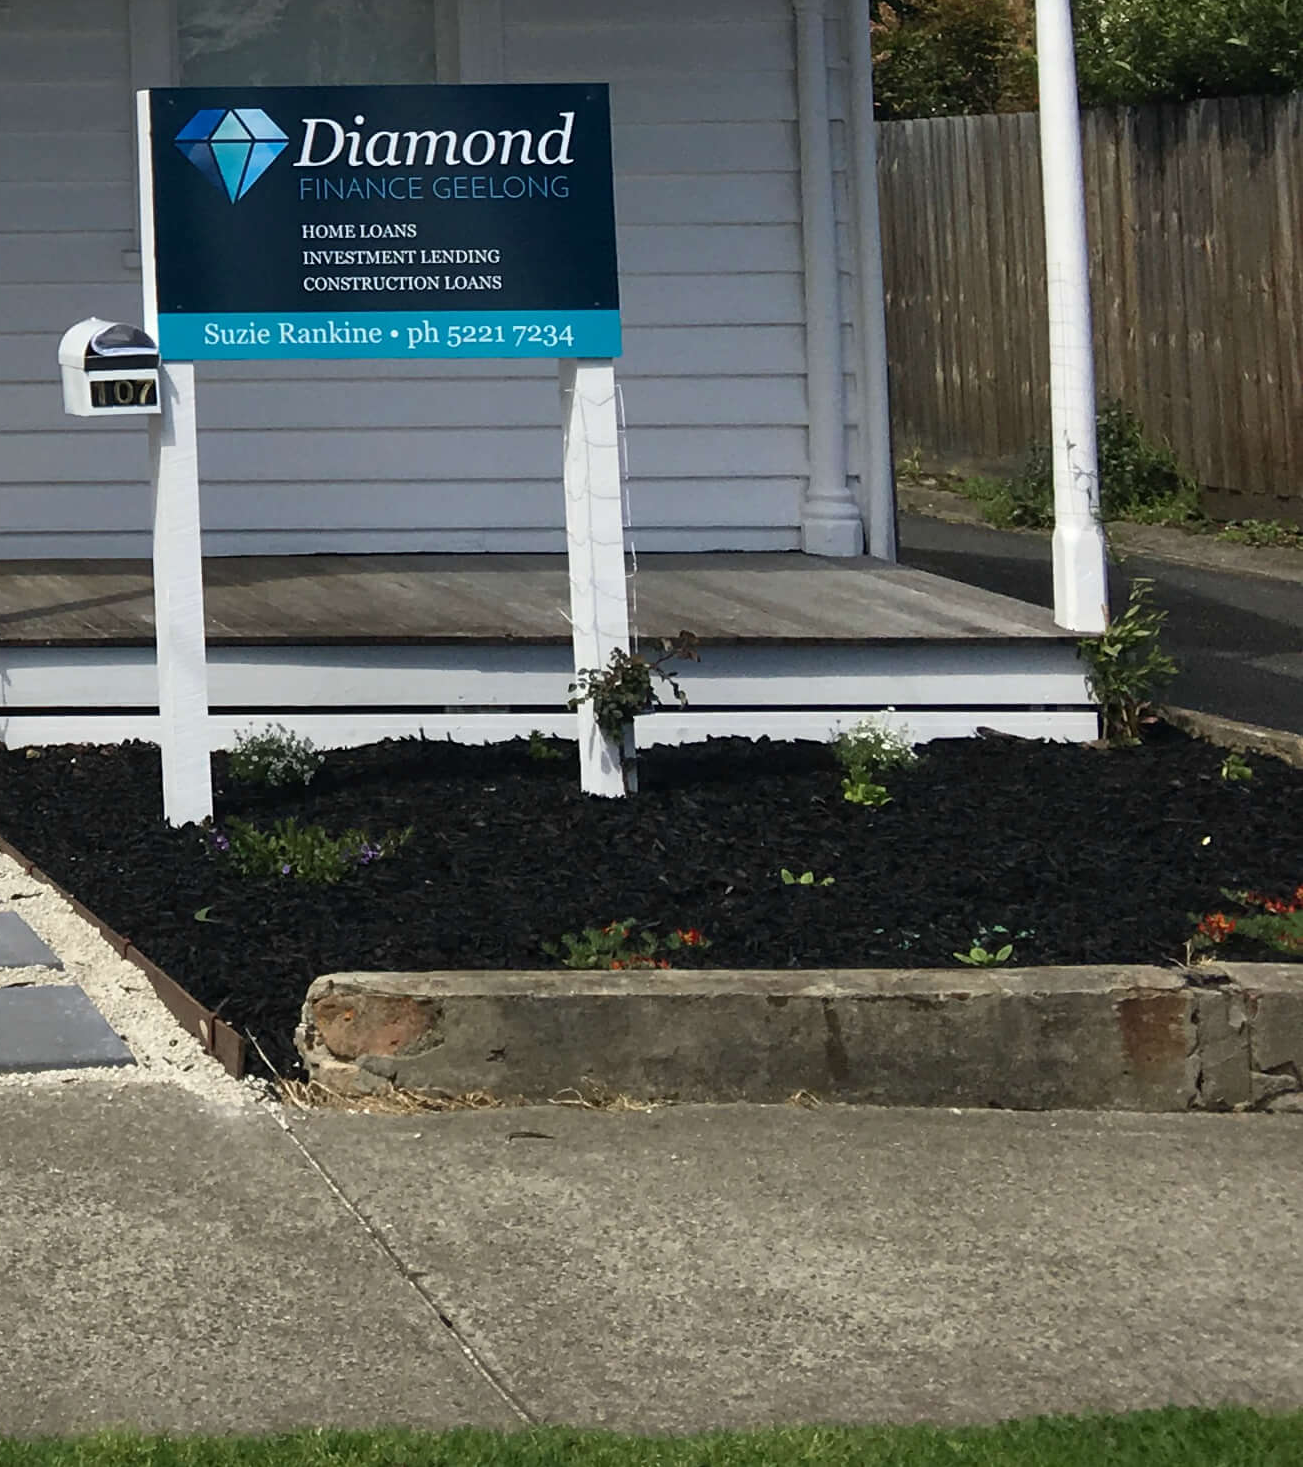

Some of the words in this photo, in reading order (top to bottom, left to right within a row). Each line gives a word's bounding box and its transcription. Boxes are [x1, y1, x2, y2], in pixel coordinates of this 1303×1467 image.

[292, 111, 576, 168] Diamond
[299, 176, 425, 201] FINANCE
[431, 175, 570, 200] GEELONG
[301, 224, 357, 240] HOME
[359, 223, 418, 240] LOANS
[302, 250, 417, 266] INVESTMENT
[420, 249, 501, 265] LENDING
[303, 276, 441, 292] CONSTRUCTION
[444, 275, 503, 291] LOANS
[204, 321, 271, 346] Suzie
[278, 320, 383, 345] Rankine
[407, 320, 440, 350] ph
[446, 325, 505, 349] 5221
[512, 325, 575, 348] 7234
[97, 379, 154, 406] 107
